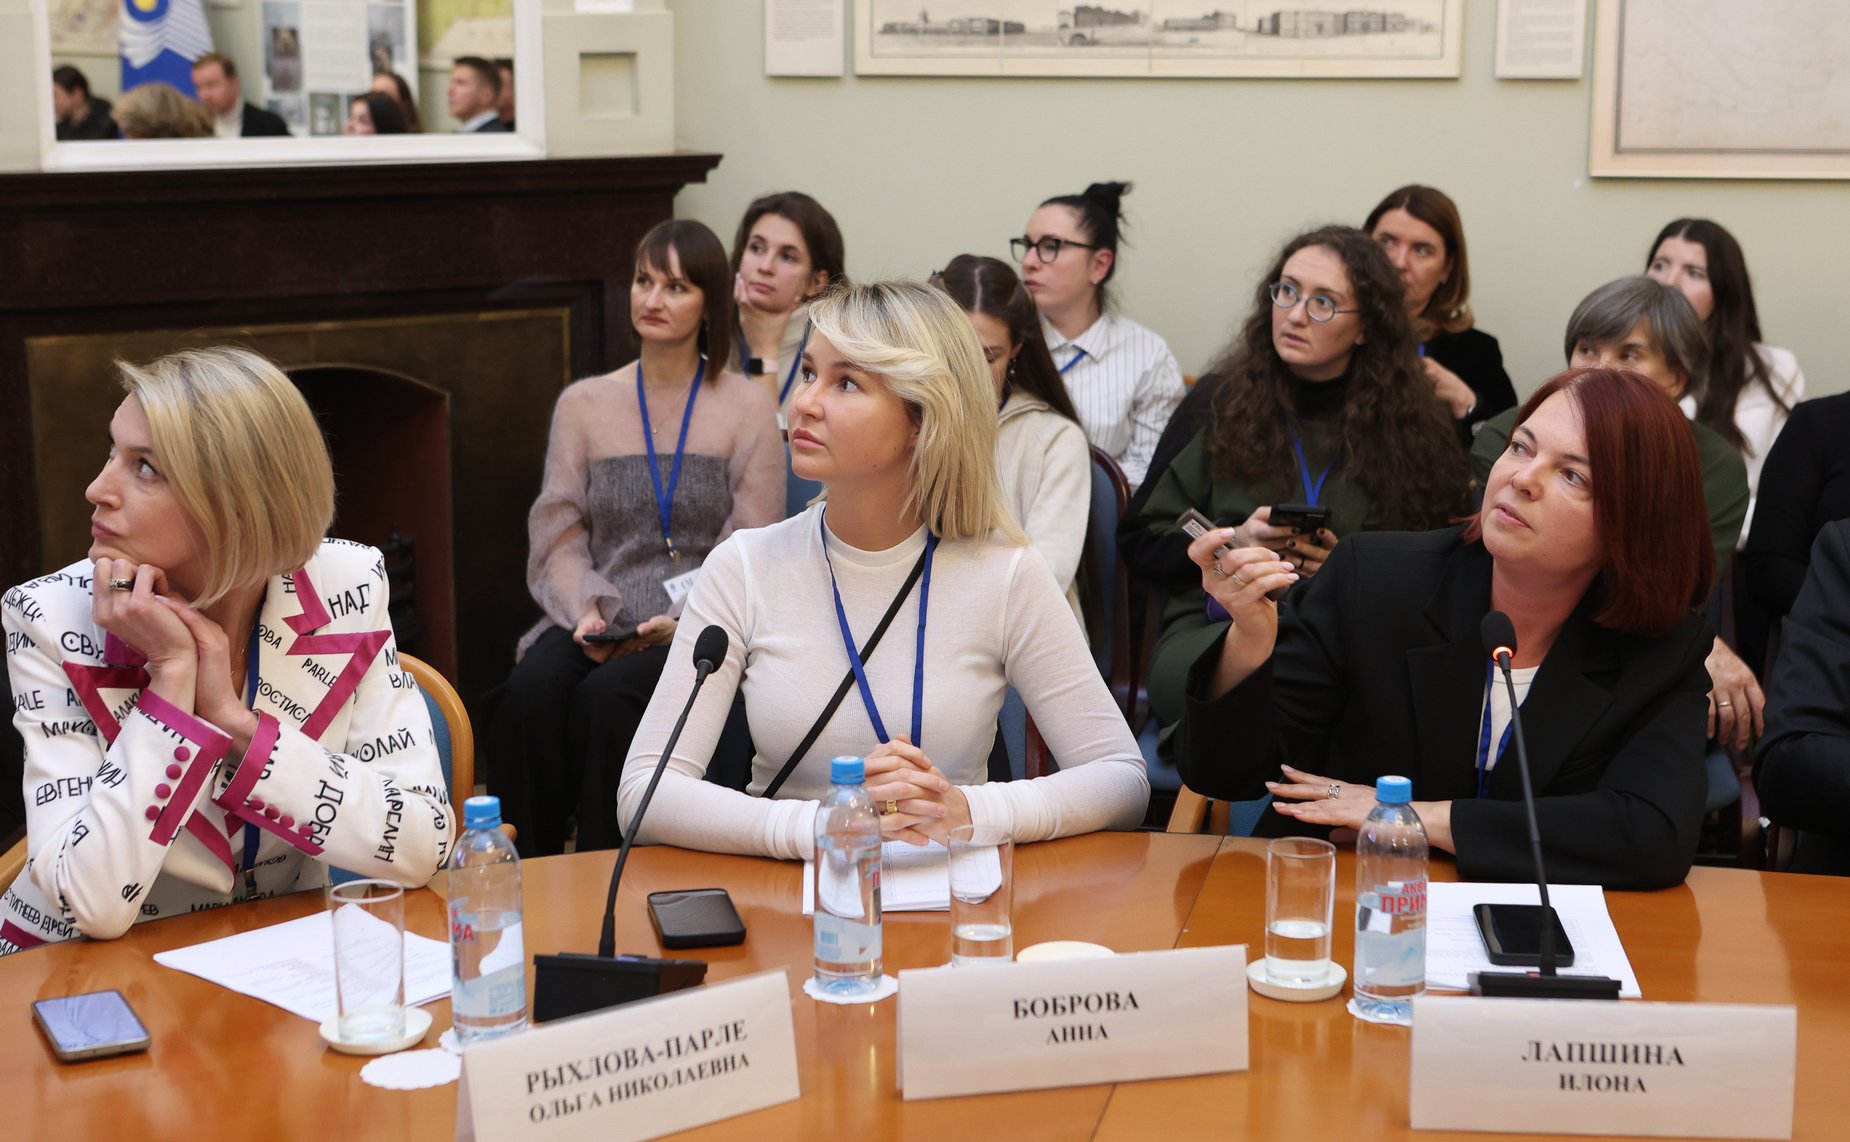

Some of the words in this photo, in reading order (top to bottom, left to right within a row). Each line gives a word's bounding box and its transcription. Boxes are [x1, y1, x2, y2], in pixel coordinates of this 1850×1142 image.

[301, 658, 338, 688] PARLE
[1013, 991, 1140, 1020] БОБРОВА
[1046, 1024, 1109, 1045] АННА
[526, 1019, 748, 1095] РЫХЛОВА-ПАРЛЕ
[1521, 1040, 1685, 1067] ЛАПШИНА
[529, 1091, 602, 1124] ОЛЬГА
[608, 1052, 750, 1105] НИКОЛАЕВНА
[1558, 1073, 1647, 1094] ИЛОНА
